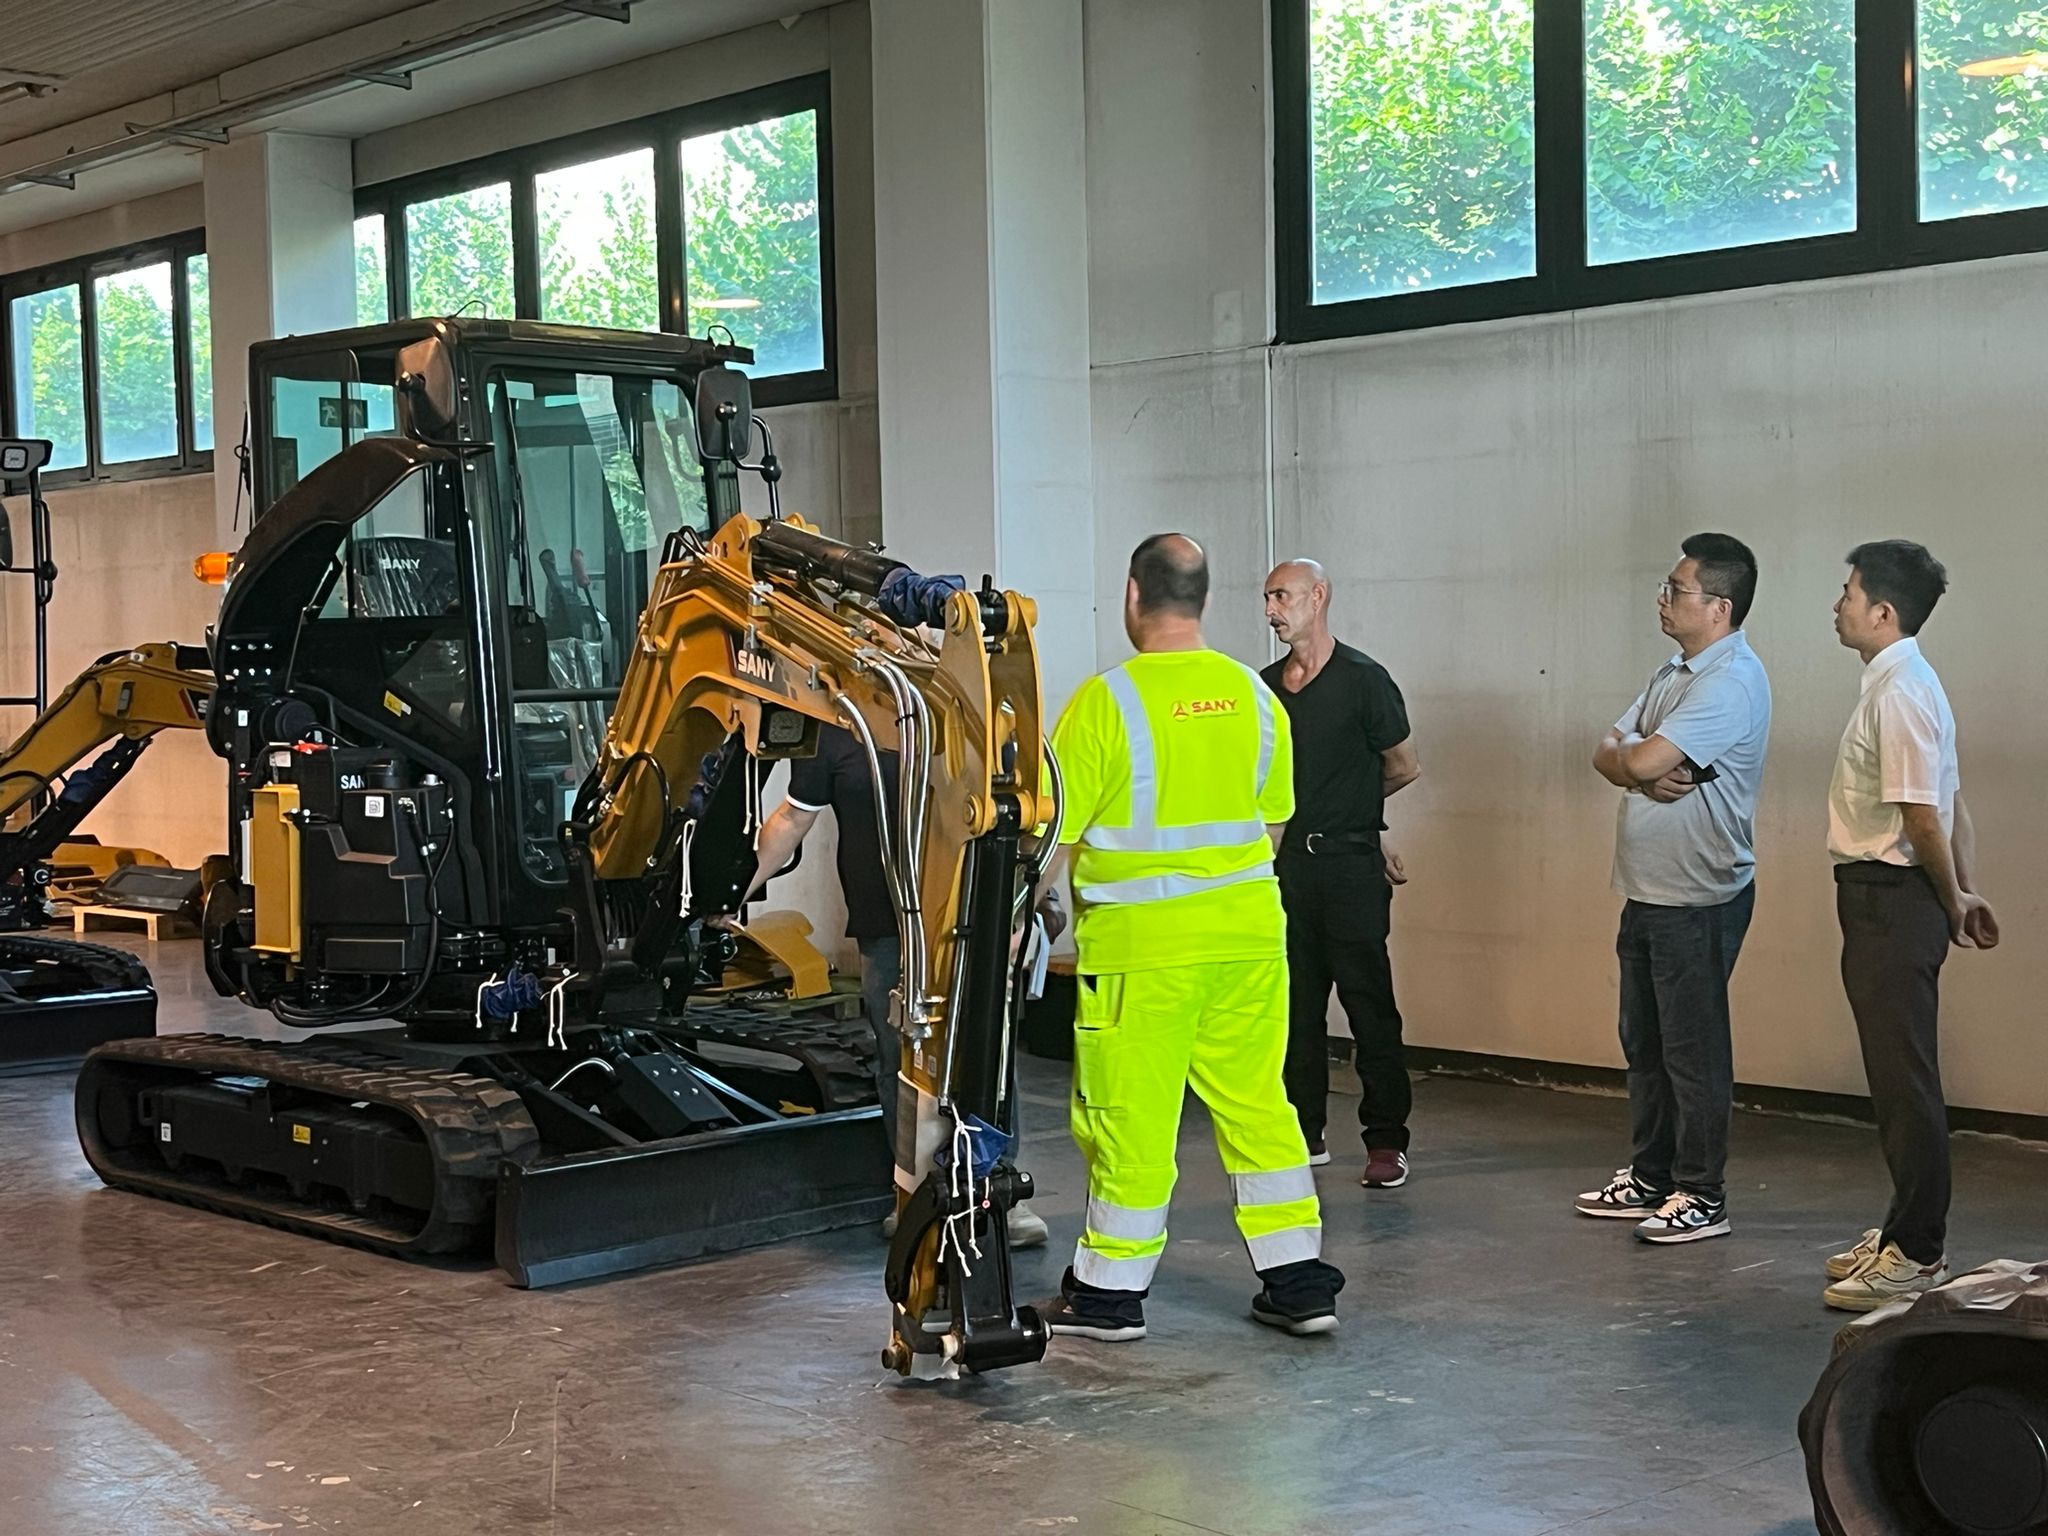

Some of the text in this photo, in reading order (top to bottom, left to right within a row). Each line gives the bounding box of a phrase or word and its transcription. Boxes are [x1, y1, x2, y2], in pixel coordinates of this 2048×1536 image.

[738, 650, 776, 682] SANY
[1192, 699, 1238, 713] SANY
[340, 774, 365, 789] SAN
